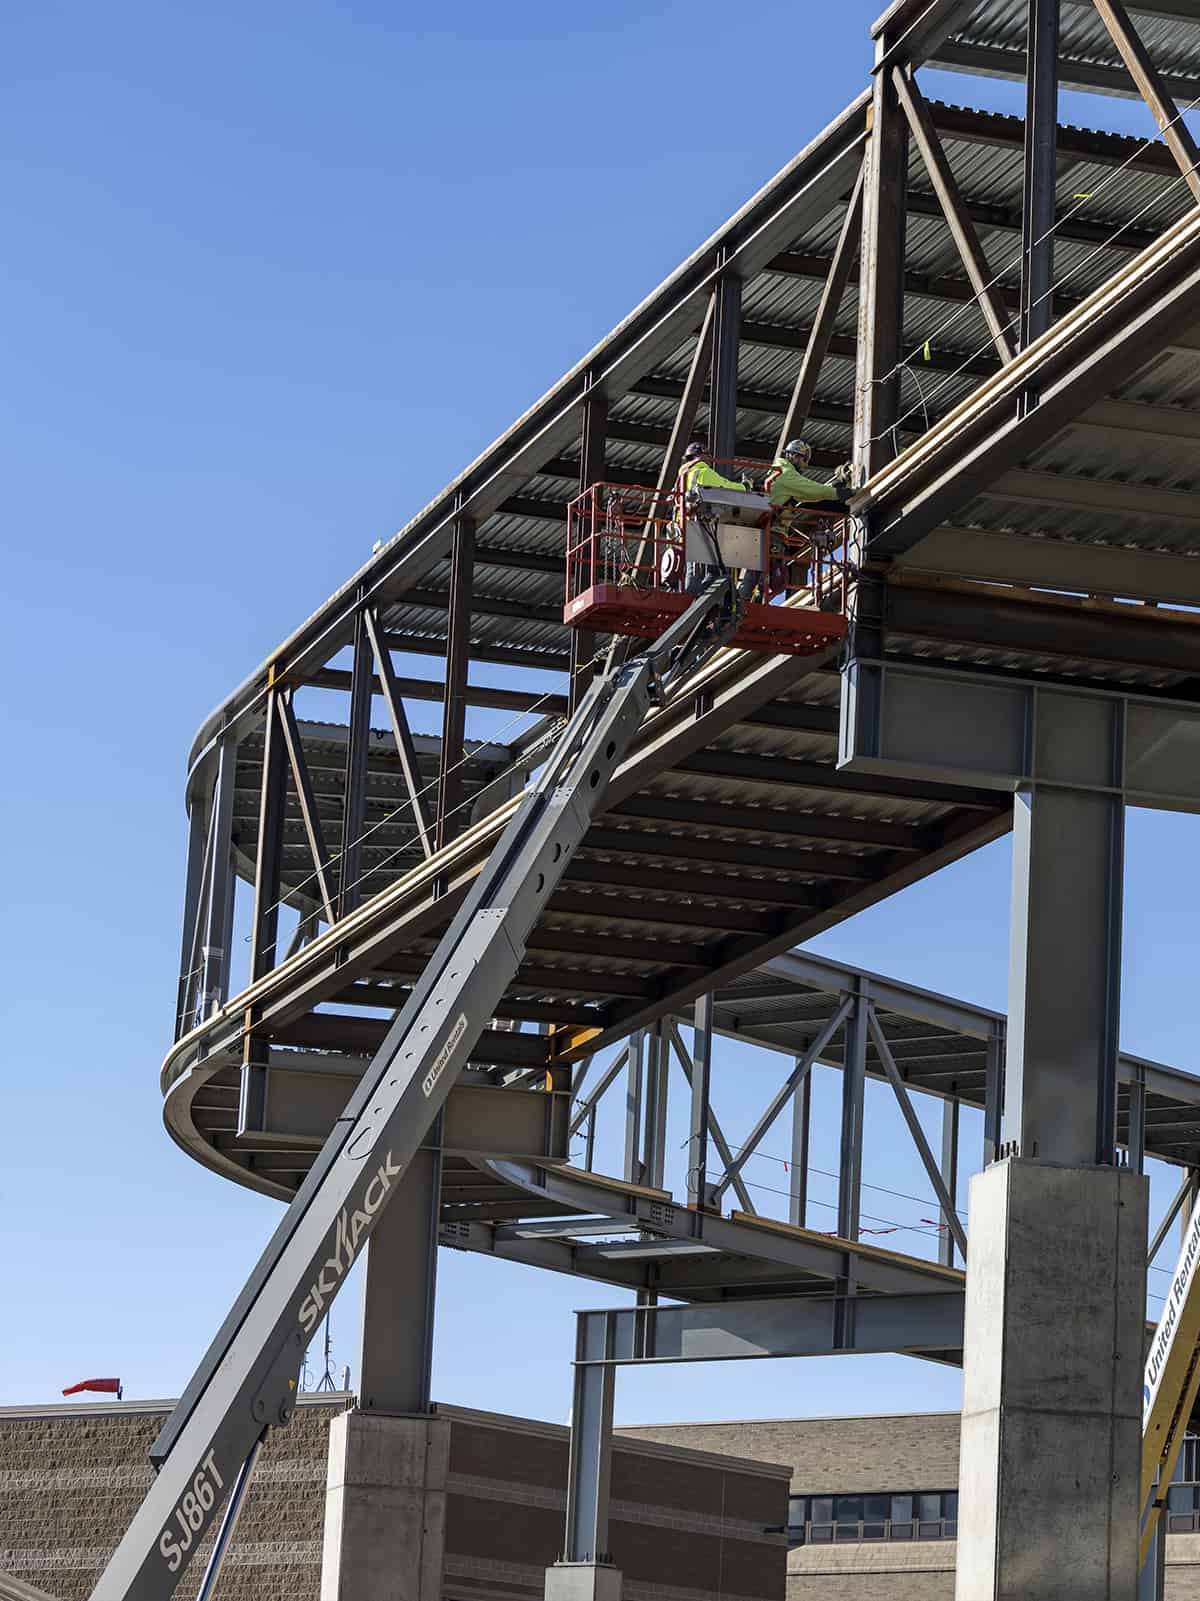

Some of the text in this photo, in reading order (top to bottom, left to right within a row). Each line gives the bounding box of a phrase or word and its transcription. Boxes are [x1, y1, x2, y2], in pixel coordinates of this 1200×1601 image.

[298, 1149, 402, 1333] SKYJACK
[1148, 1299, 1177, 1386] United
[160, 1447, 224, 1573] SJ86T
